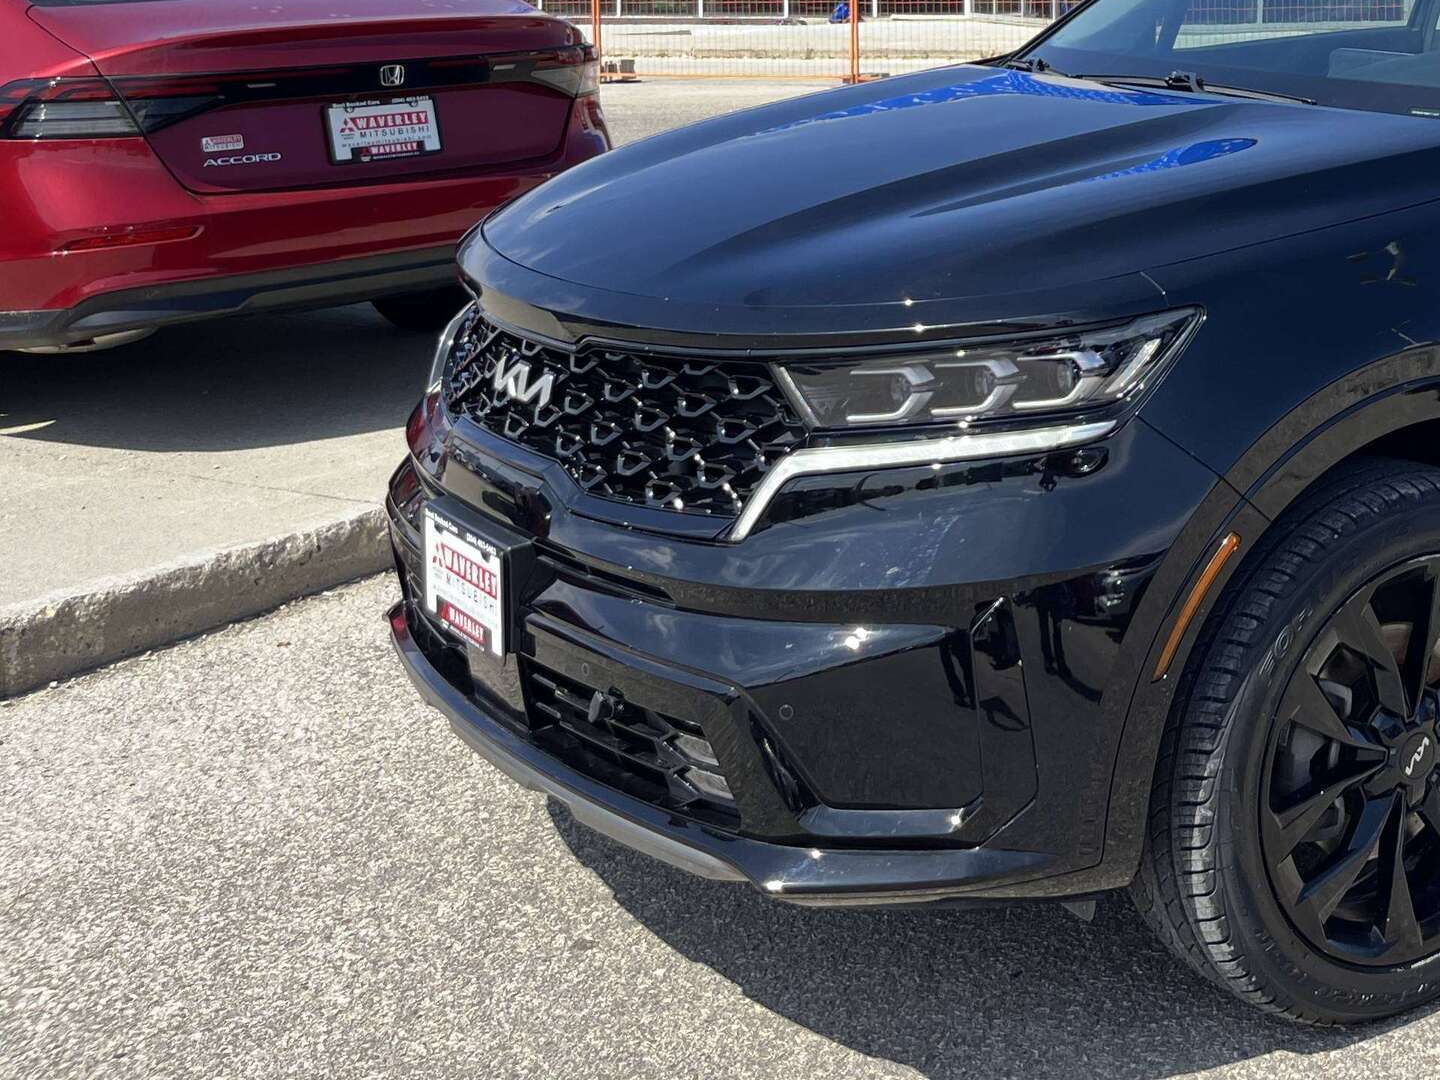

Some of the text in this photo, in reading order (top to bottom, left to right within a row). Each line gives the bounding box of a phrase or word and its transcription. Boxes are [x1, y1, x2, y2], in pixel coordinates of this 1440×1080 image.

[356, 111, 427, 130] WAVERLEY
[360, 126, 430, 138] MITSUBISHI
[369, 142, 418, 154] WAVERLEY
[203, 153, 281, 167] ACCORD
[445, 547, 497, 599] WAVERLEY
[448, 606, 485, 641] WAVERLEY
